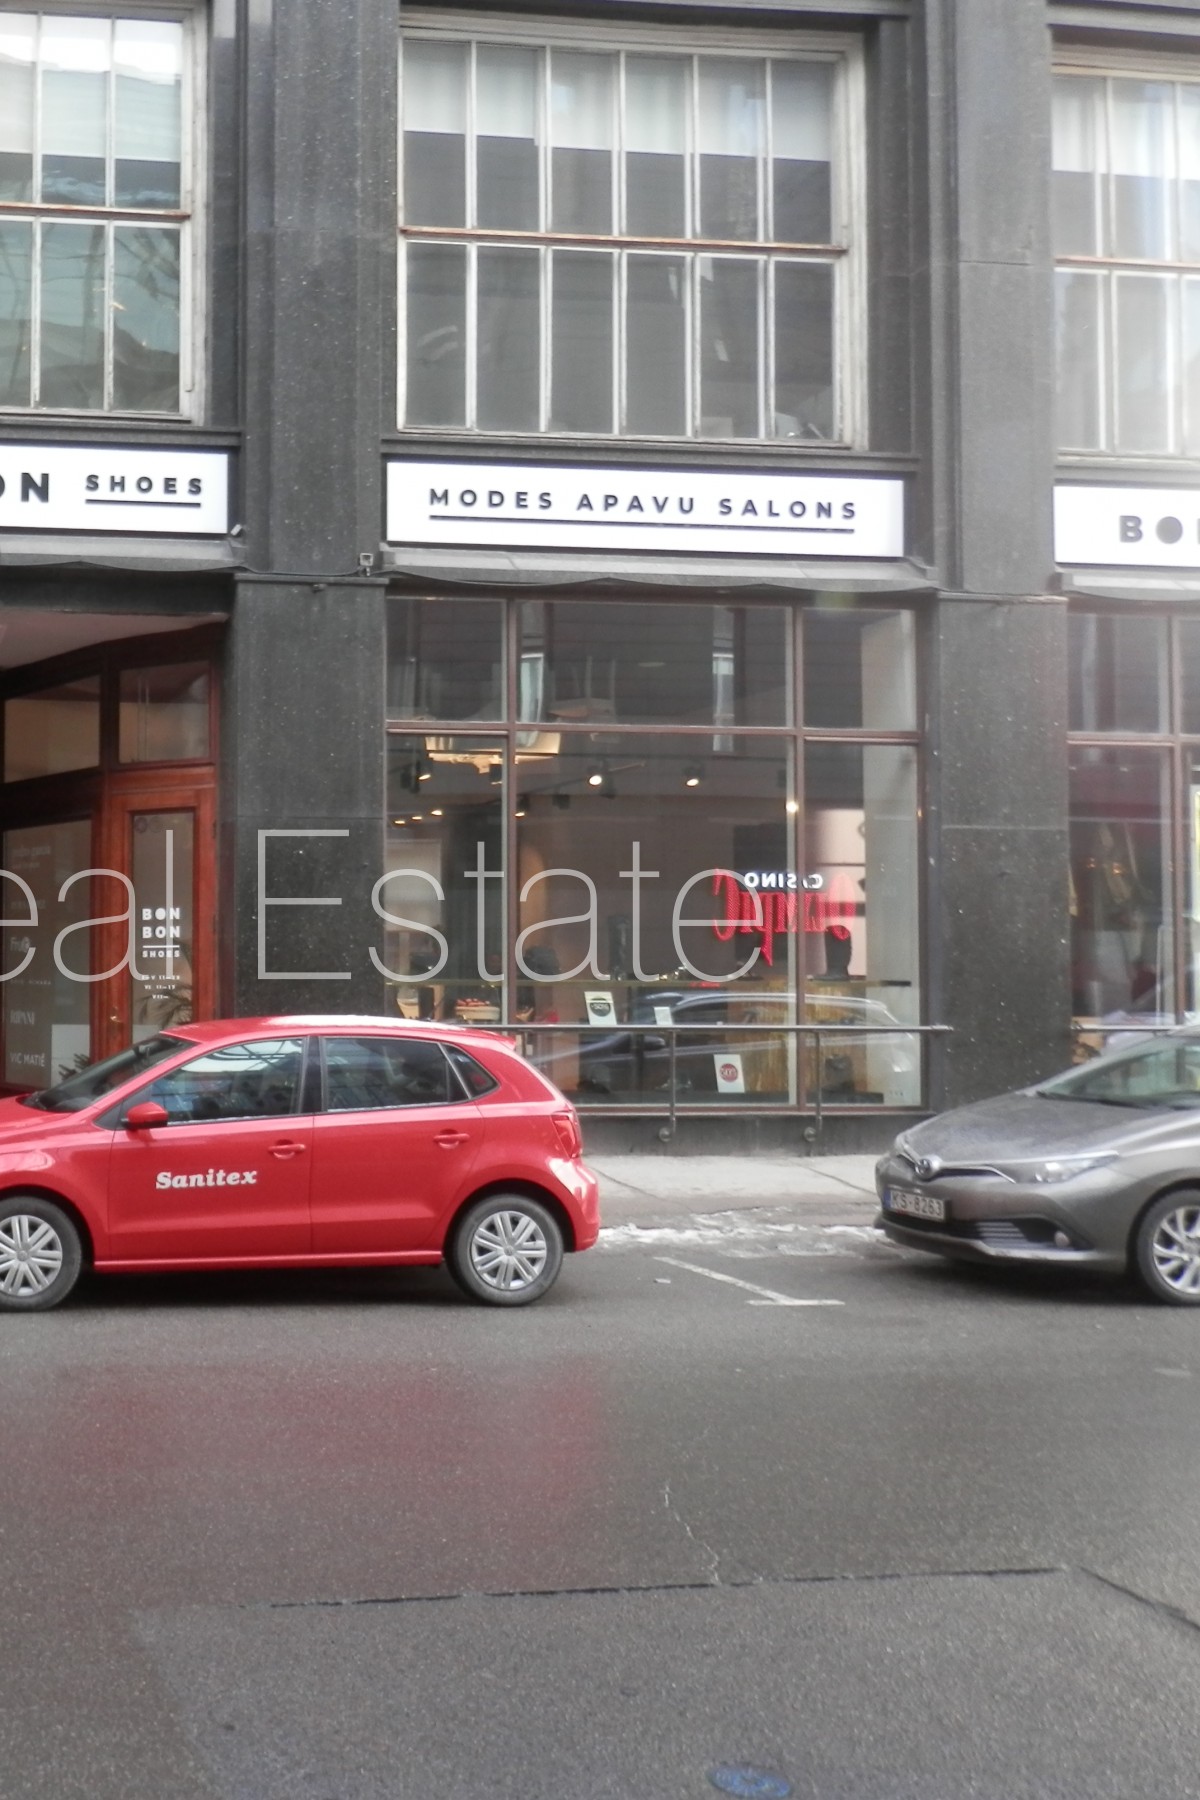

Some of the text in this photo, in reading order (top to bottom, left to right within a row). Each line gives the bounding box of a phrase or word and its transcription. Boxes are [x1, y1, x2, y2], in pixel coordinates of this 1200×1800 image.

[85, 474, 203, 495] SHOES
[429, 488, 856, 519] MODES APAVU SALONS
[1119, 515, 1200, 545] BO
[141, 907, 181, 921] BON
[141, 926, 181, 939] BON
[142, 950, 181, 958] SHOES
[155, 1168, 258, 1189] Sanitex
